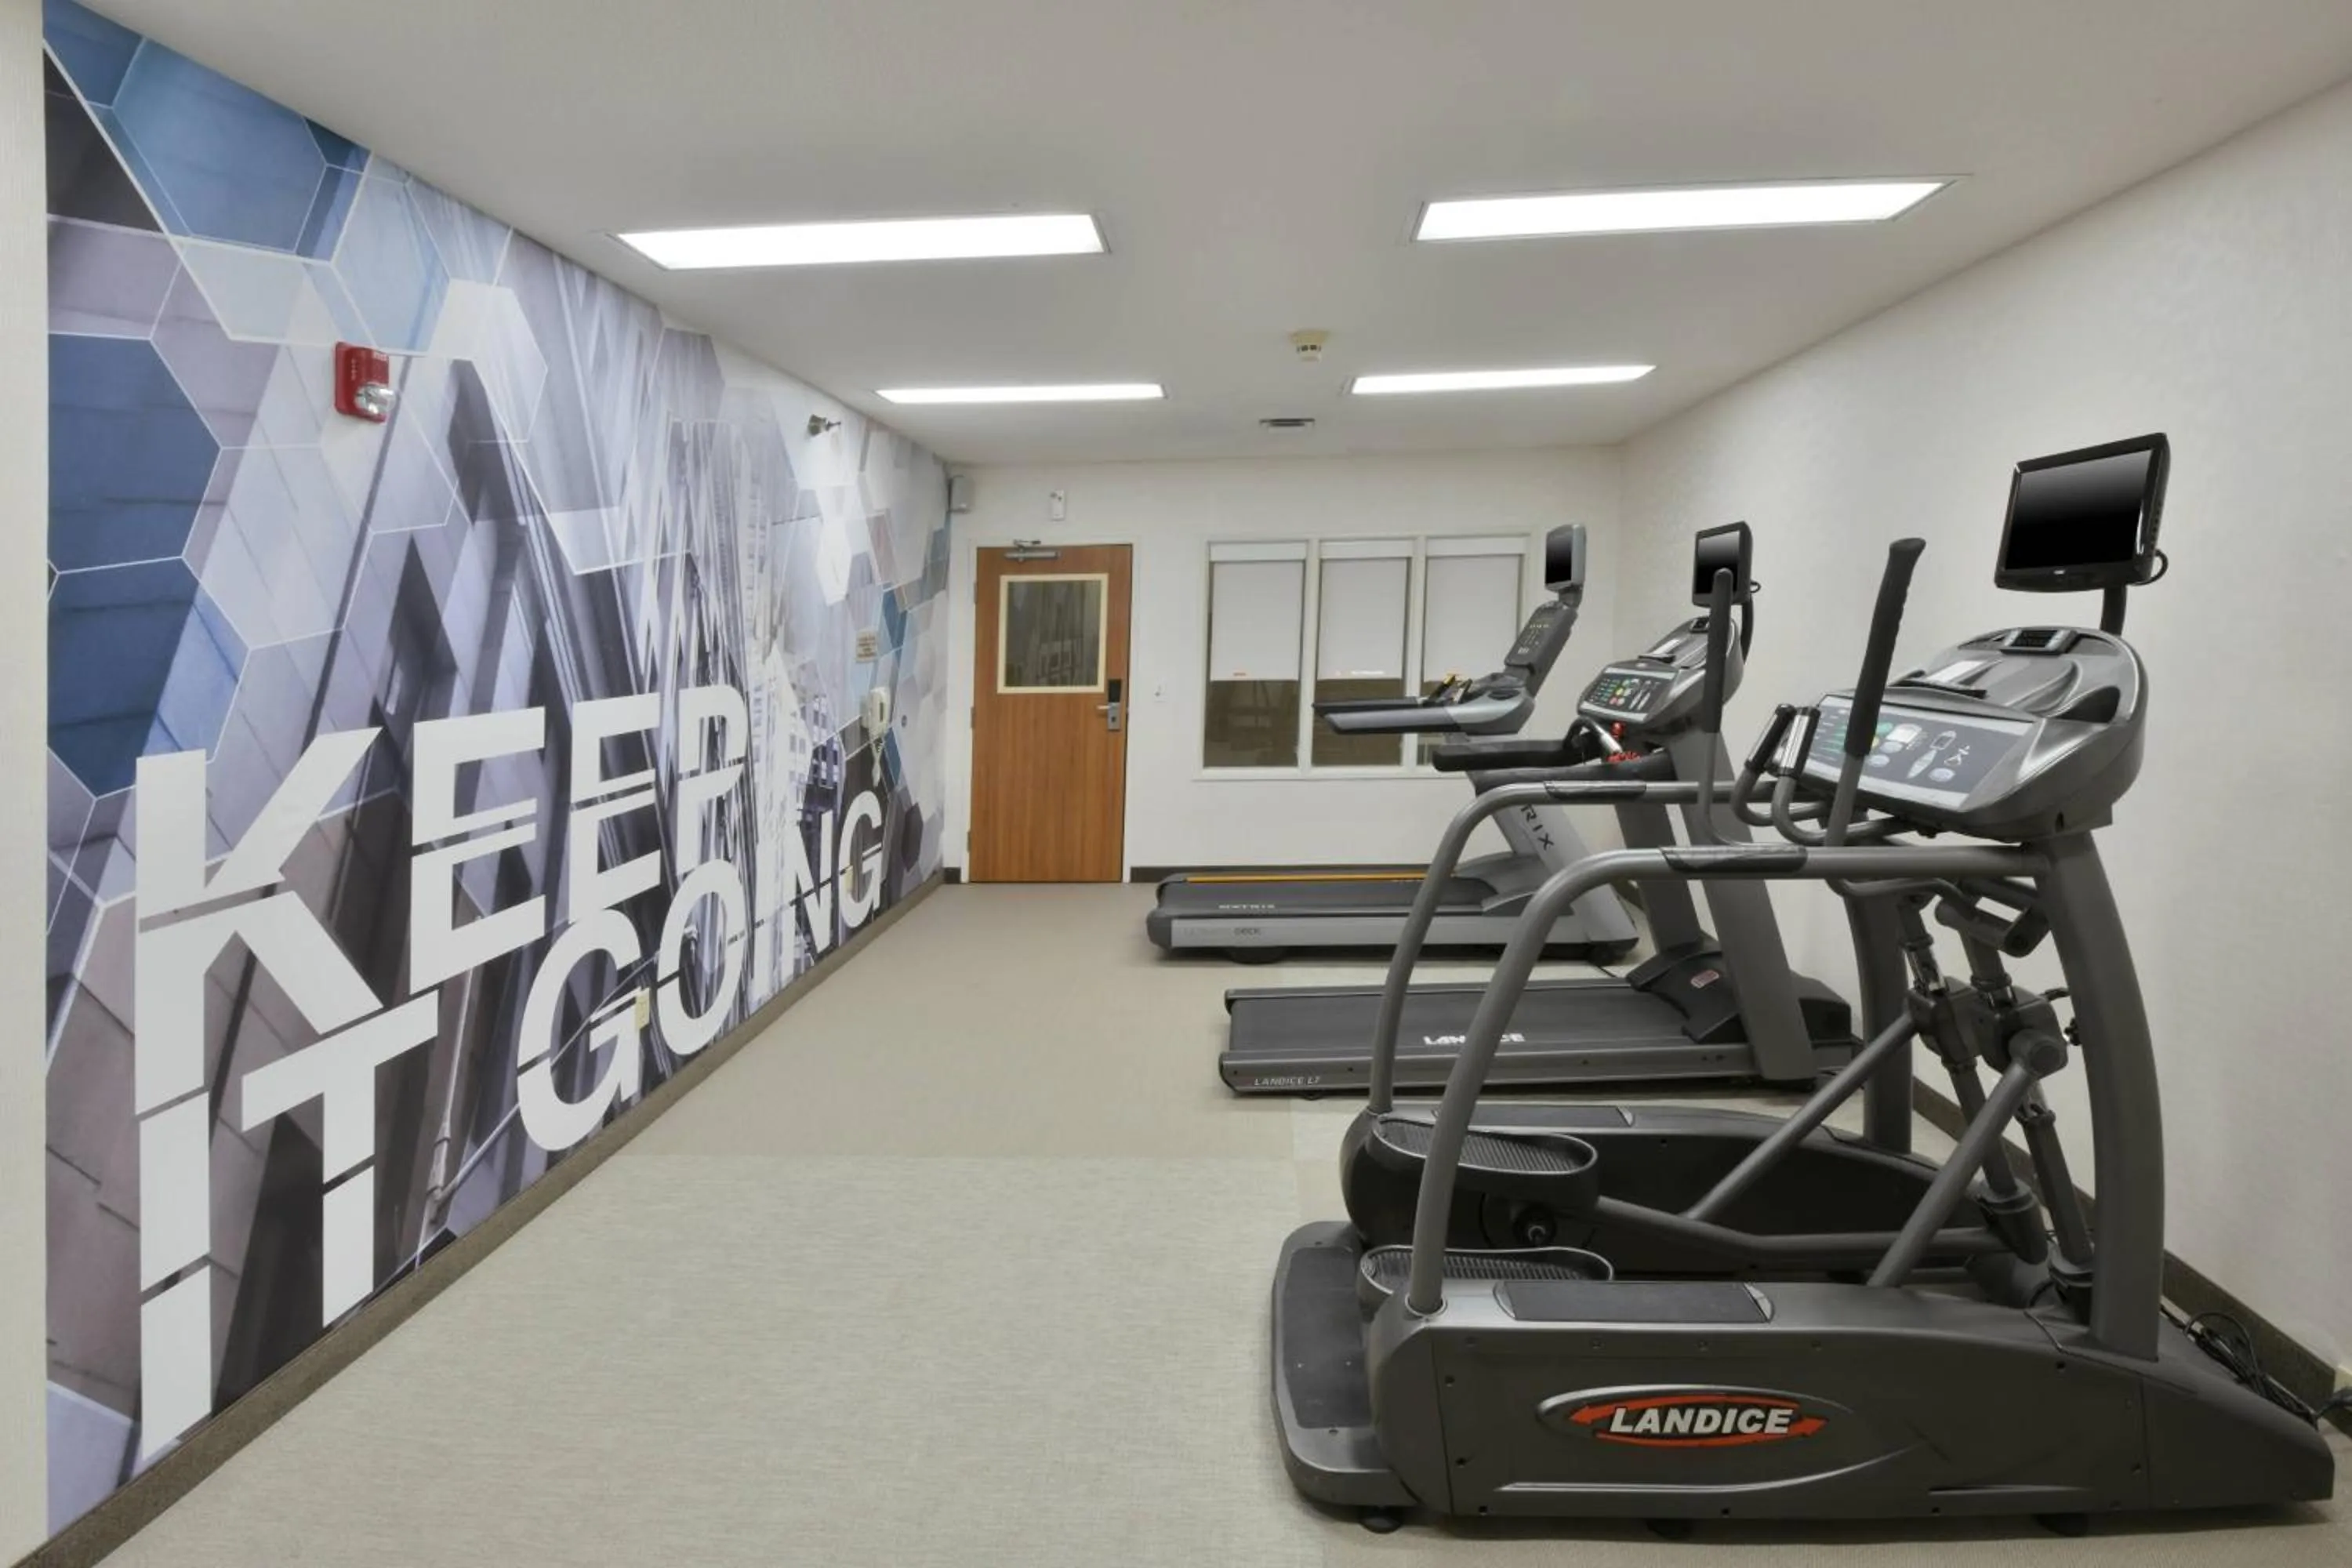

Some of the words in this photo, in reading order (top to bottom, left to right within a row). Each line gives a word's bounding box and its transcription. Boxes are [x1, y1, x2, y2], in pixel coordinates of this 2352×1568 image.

[1520, 804, 1555, 851] RIX
[136, 684, 749, 1115] KEEP
[1423, 1033, 1526, 1045] LANCE
[139, 989, 438, 1460] IT
[517, 789, 883, 1151] GOING
[1610, 1407, 1794, 1434] LANDICE
